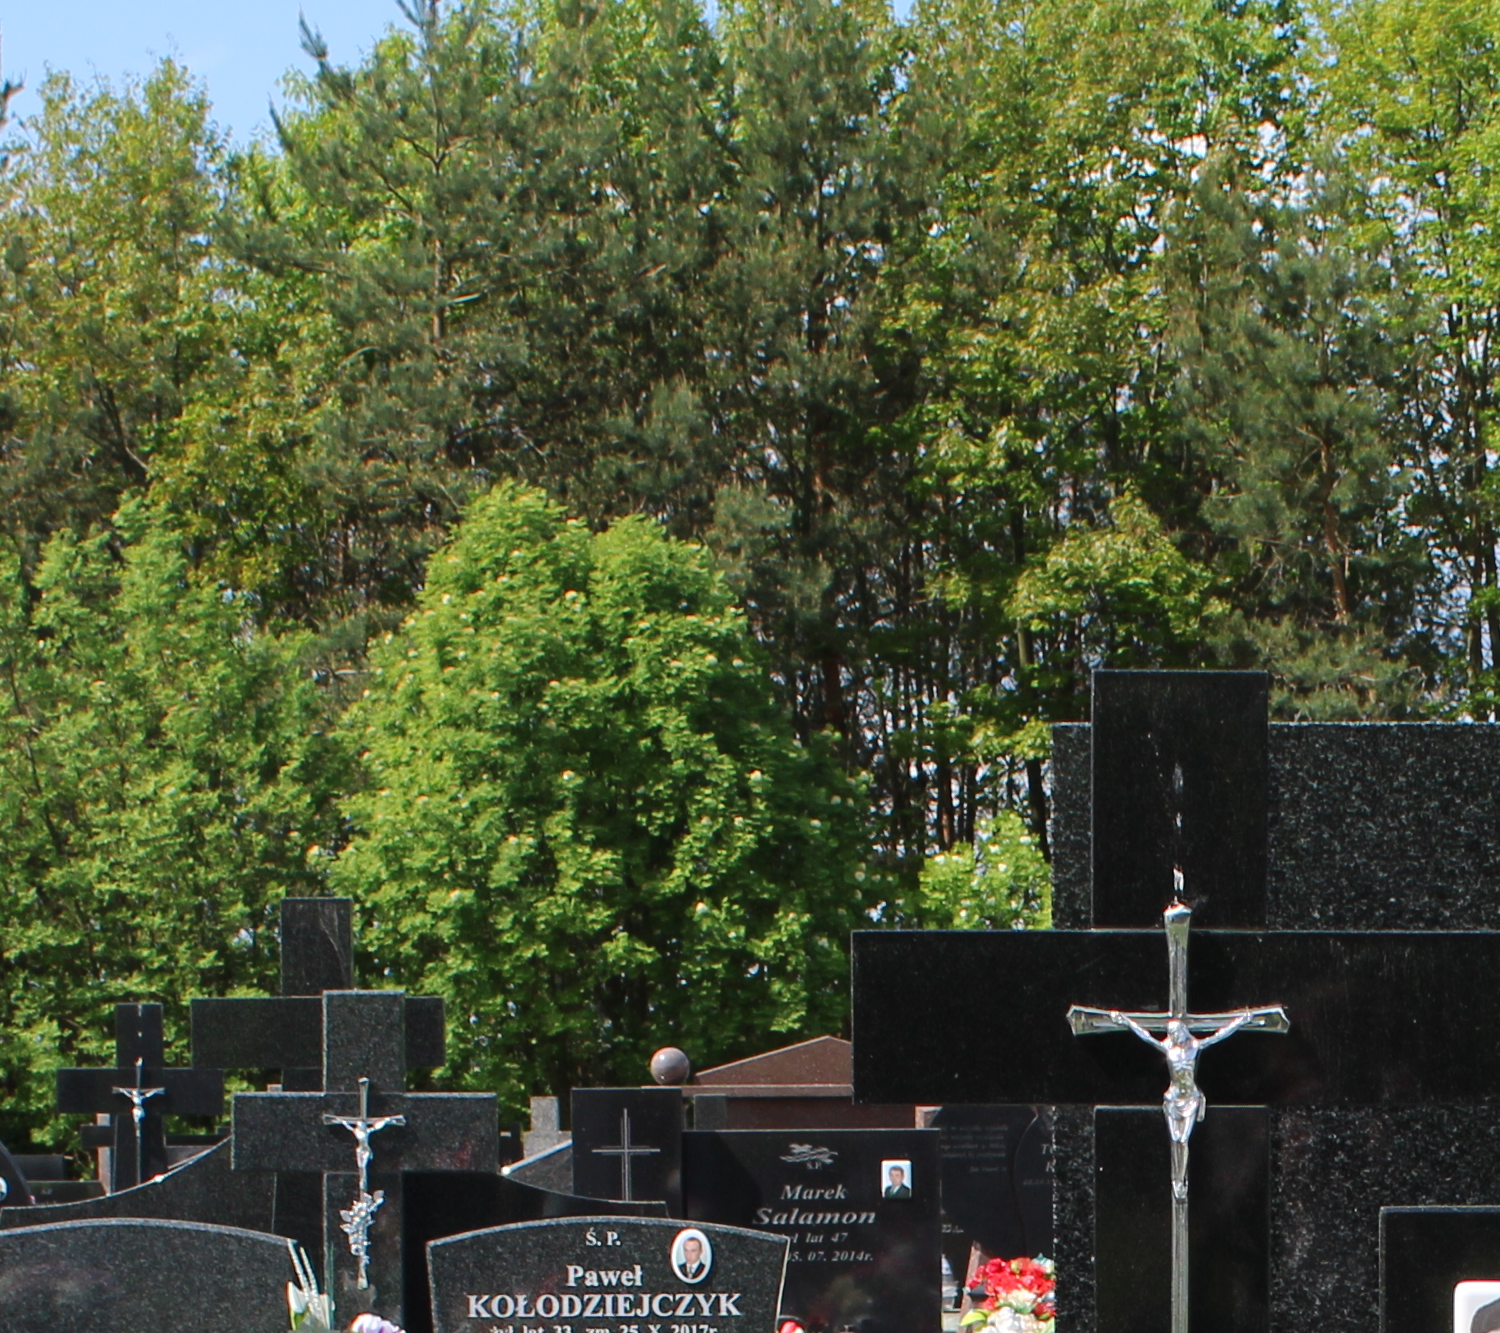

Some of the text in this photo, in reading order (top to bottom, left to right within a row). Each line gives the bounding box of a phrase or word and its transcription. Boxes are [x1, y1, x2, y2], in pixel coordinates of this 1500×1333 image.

[780, 1184, 848, 1200] Marek
[752, 1208, 877, 1225] Salamon
[806, 1233, 824, 1243] lat
[831, 1233, 849, 1243] 47
[807, 1251, 827, 1262] 07.
[831, 1251, 874, 1262] 2014r.
[565, 1264, 643, 1287] Paweł
[466, 1292, 742, 1319] KOŁODZIEJCZYK
